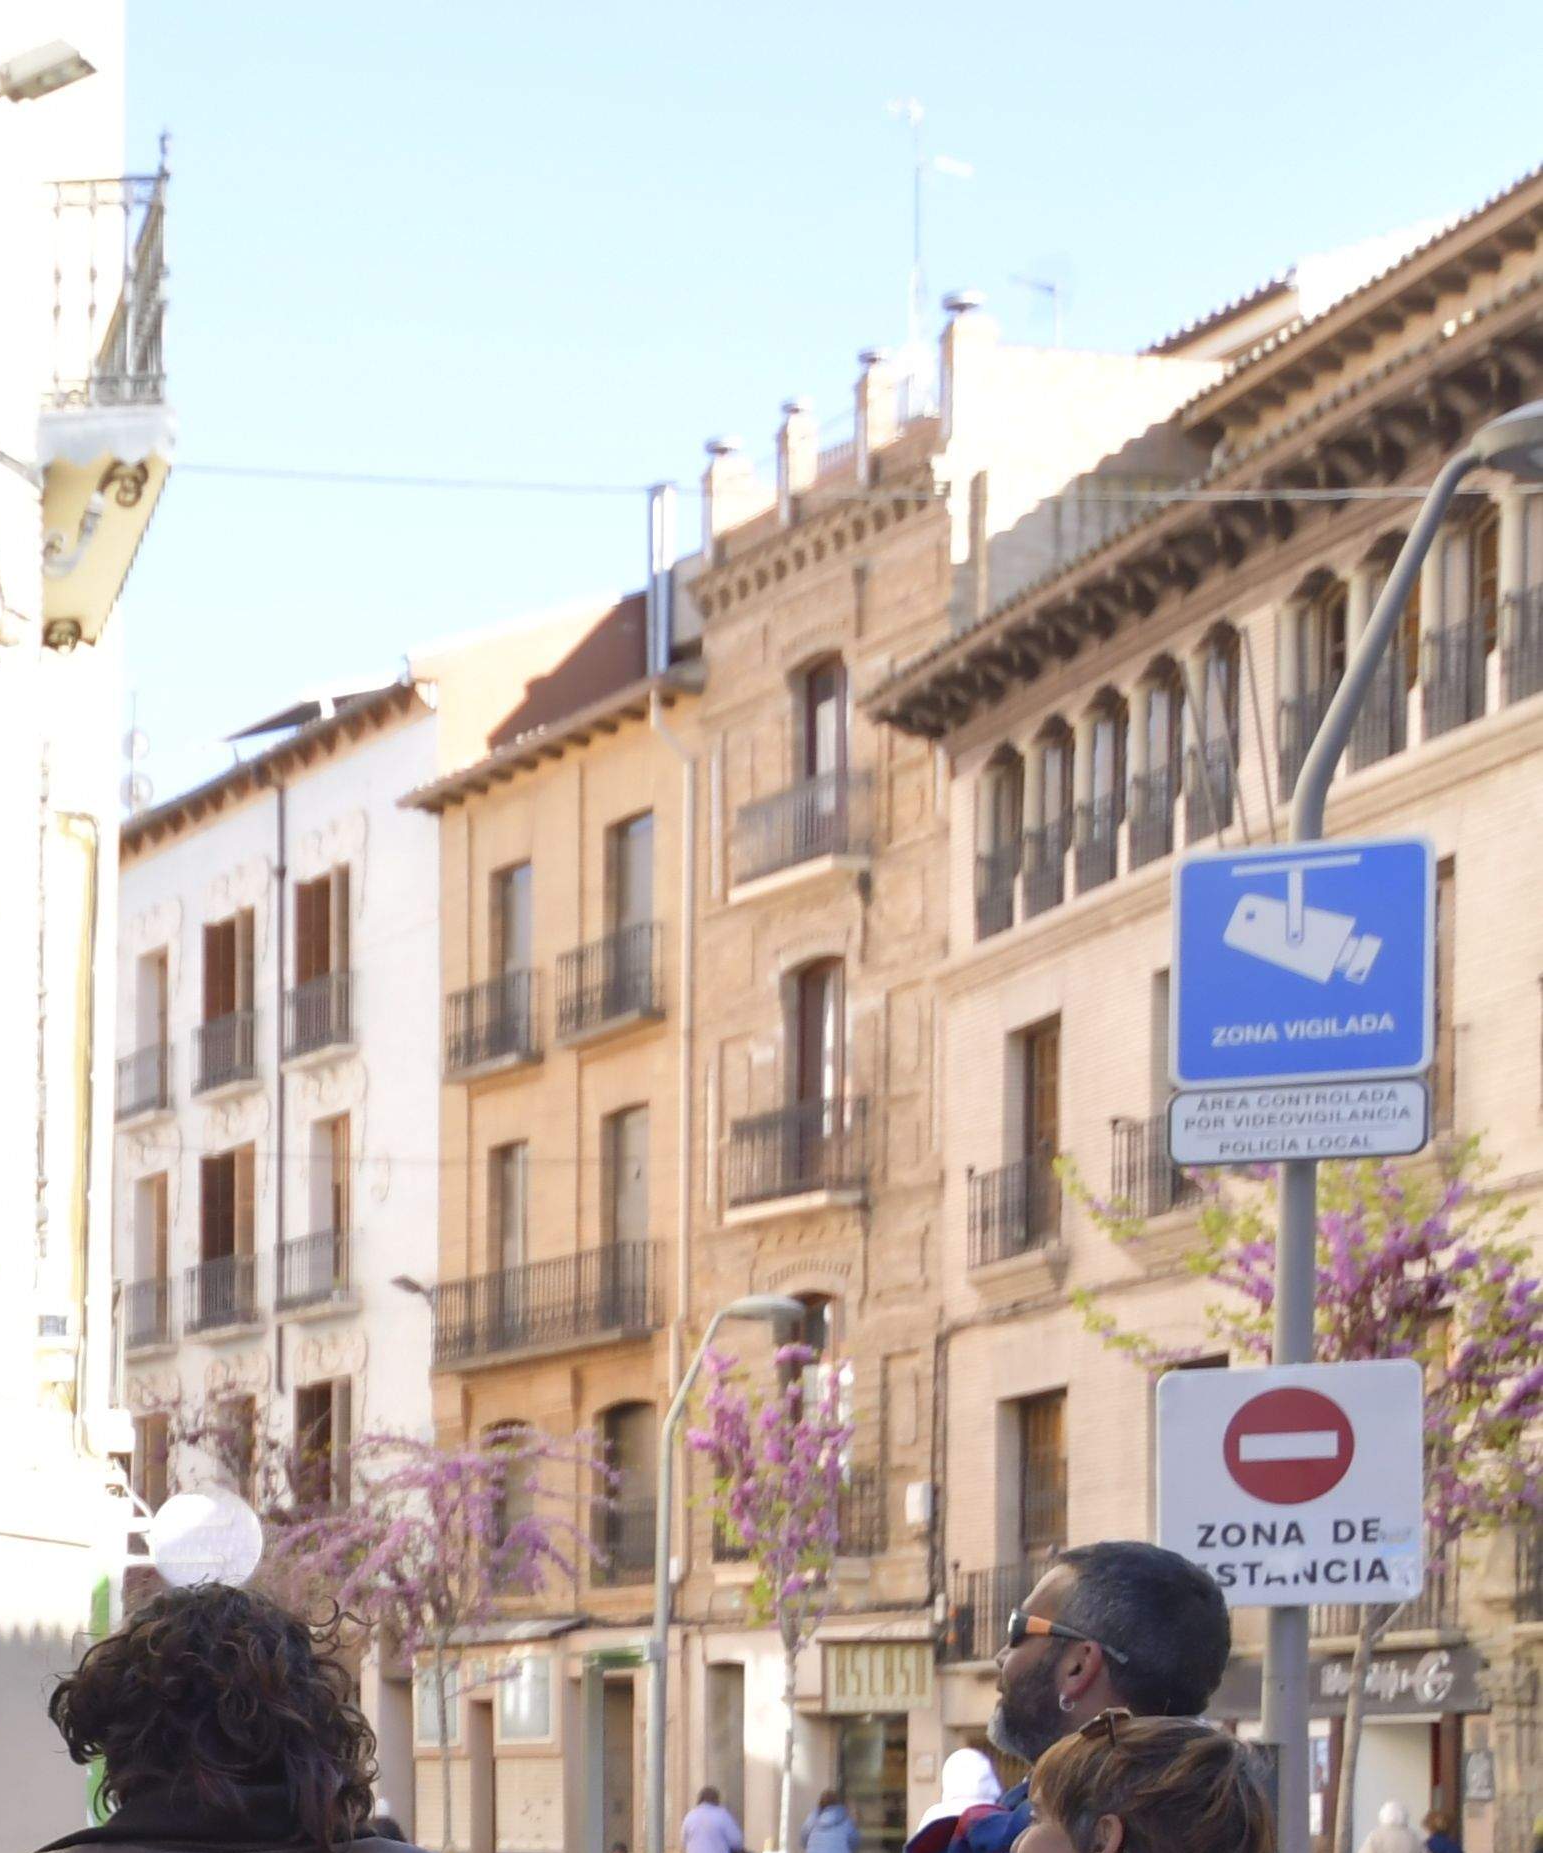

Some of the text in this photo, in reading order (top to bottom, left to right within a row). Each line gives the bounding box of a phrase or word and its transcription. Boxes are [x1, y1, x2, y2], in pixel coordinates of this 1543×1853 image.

[1211, 1012, 1395, 1048] ZONA VIGILADA
[1256, 1087, 1399, 1109] CONTROLADA
[1184, 1105, 1412, 1131] POR VIDEOVIGILANCIA
[1306, 1133, 1372, 1151] LOCAL
[1196, 1517, 1382, 1549] ZONA DE
[1198, 1557, 1390, 1588] STANCIA
